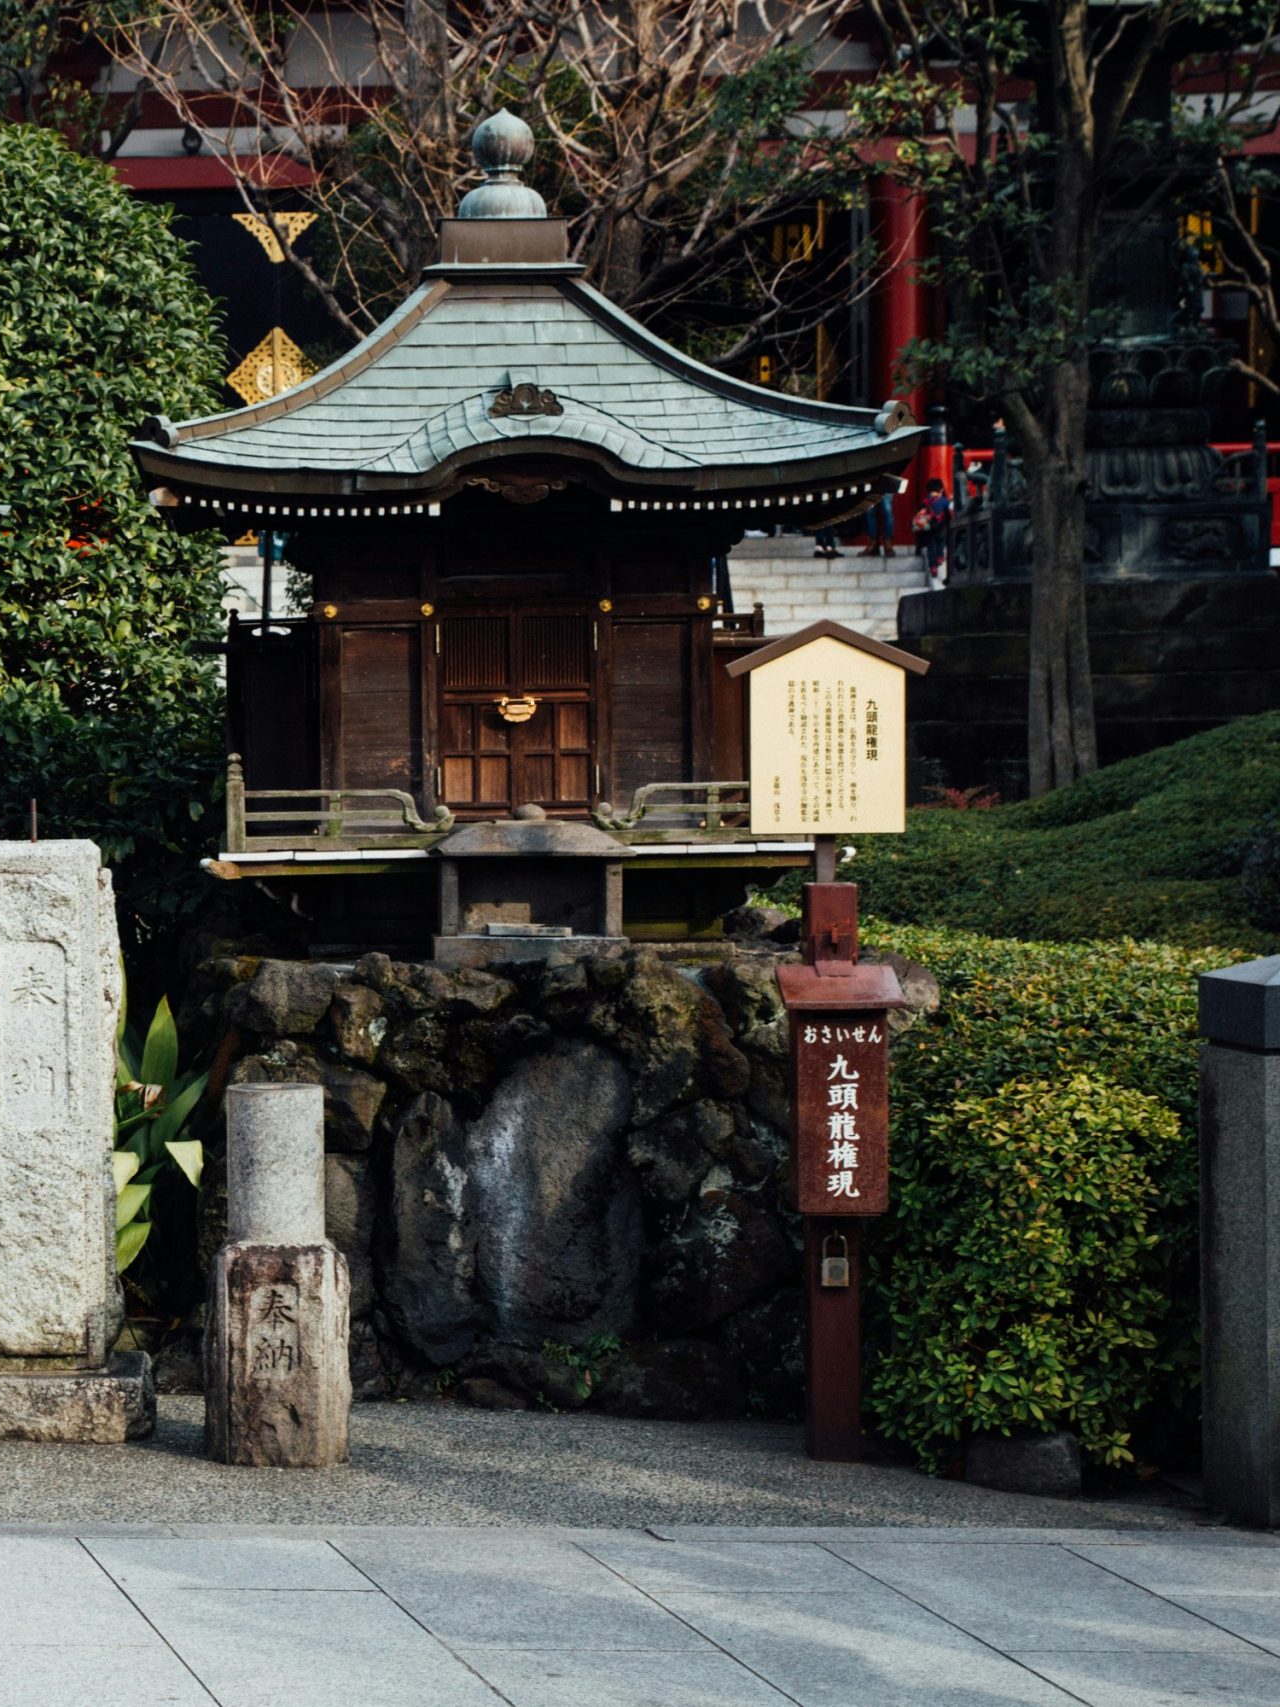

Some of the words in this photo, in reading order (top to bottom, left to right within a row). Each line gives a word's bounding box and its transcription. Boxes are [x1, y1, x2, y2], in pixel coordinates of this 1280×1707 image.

[866, 699, 878, 761] 九頭龍権現
[10, 965, 58, 1097] 奉納
[804, 1025, 882, 1044] おさいせん
[826, 1054, 860, 1198] 九頭龍権現
[252, 1288, 296, 1371] 奉納
